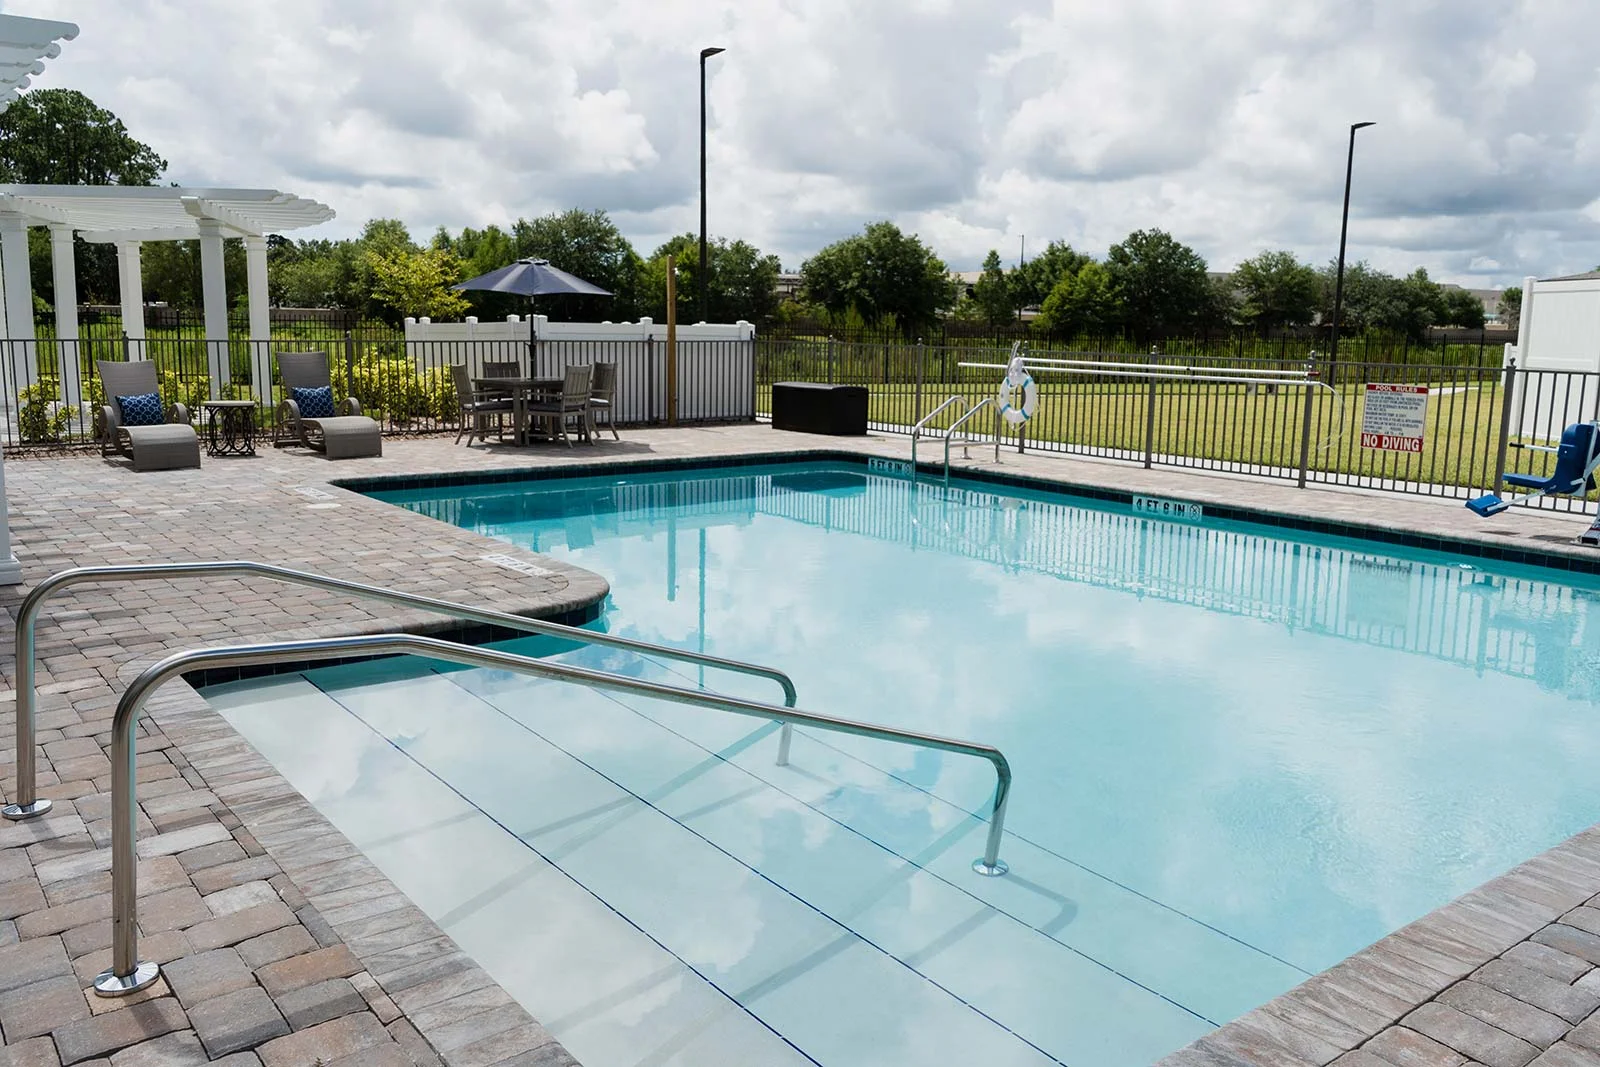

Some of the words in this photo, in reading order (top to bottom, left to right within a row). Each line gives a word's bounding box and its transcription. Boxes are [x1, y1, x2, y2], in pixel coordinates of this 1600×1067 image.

[1375, 384, 1392, 392] POOL
[1395, 385, 1418, 393] RULES
[1363, 434, 1378, 448] NO
[1382, 436, 1420, 451] DIVING
[1174, 503, 1185, 517] IN
